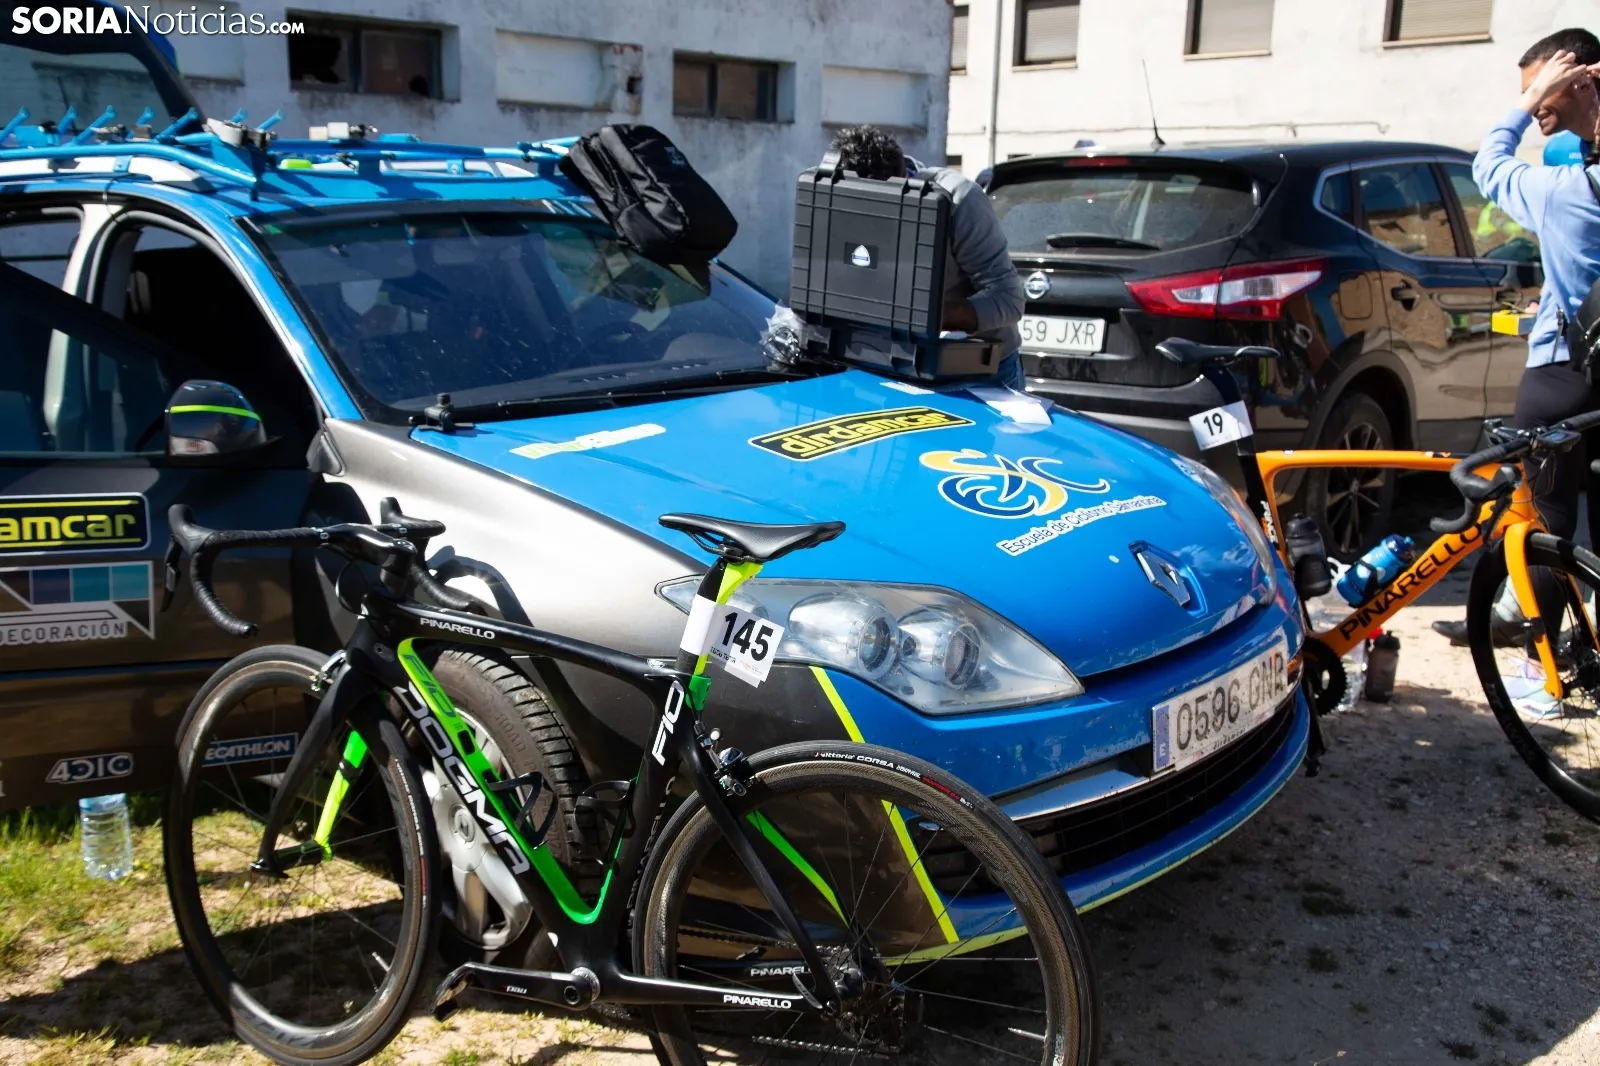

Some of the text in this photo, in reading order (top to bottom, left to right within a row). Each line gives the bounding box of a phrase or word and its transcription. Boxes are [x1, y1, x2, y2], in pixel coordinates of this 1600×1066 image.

[1022, 319, 1096, 345] 59 JXR
[780, 412, 947, 454] dirdamcar
[1203, 412, 1224, 437] 19
[1001, 526, 1054, 554] Escuela
[1051, 520, 1070, 532] de
[1065, 502, 1113, 526] Ciclismo
[1338, 522, 1482, 641] PINARELLO
[420, 617, 496, 640] PINARELLO
[721, 611, 774, 662] 145
[1176, 678, 1240, 751] 0596
[204, 739, 291, 761] ECATHLON
[856, 754, 894, 769] CORSA
[750, 965, 811, 977] PINAREL
[723, 994, 792, 1009] PINARELLO
